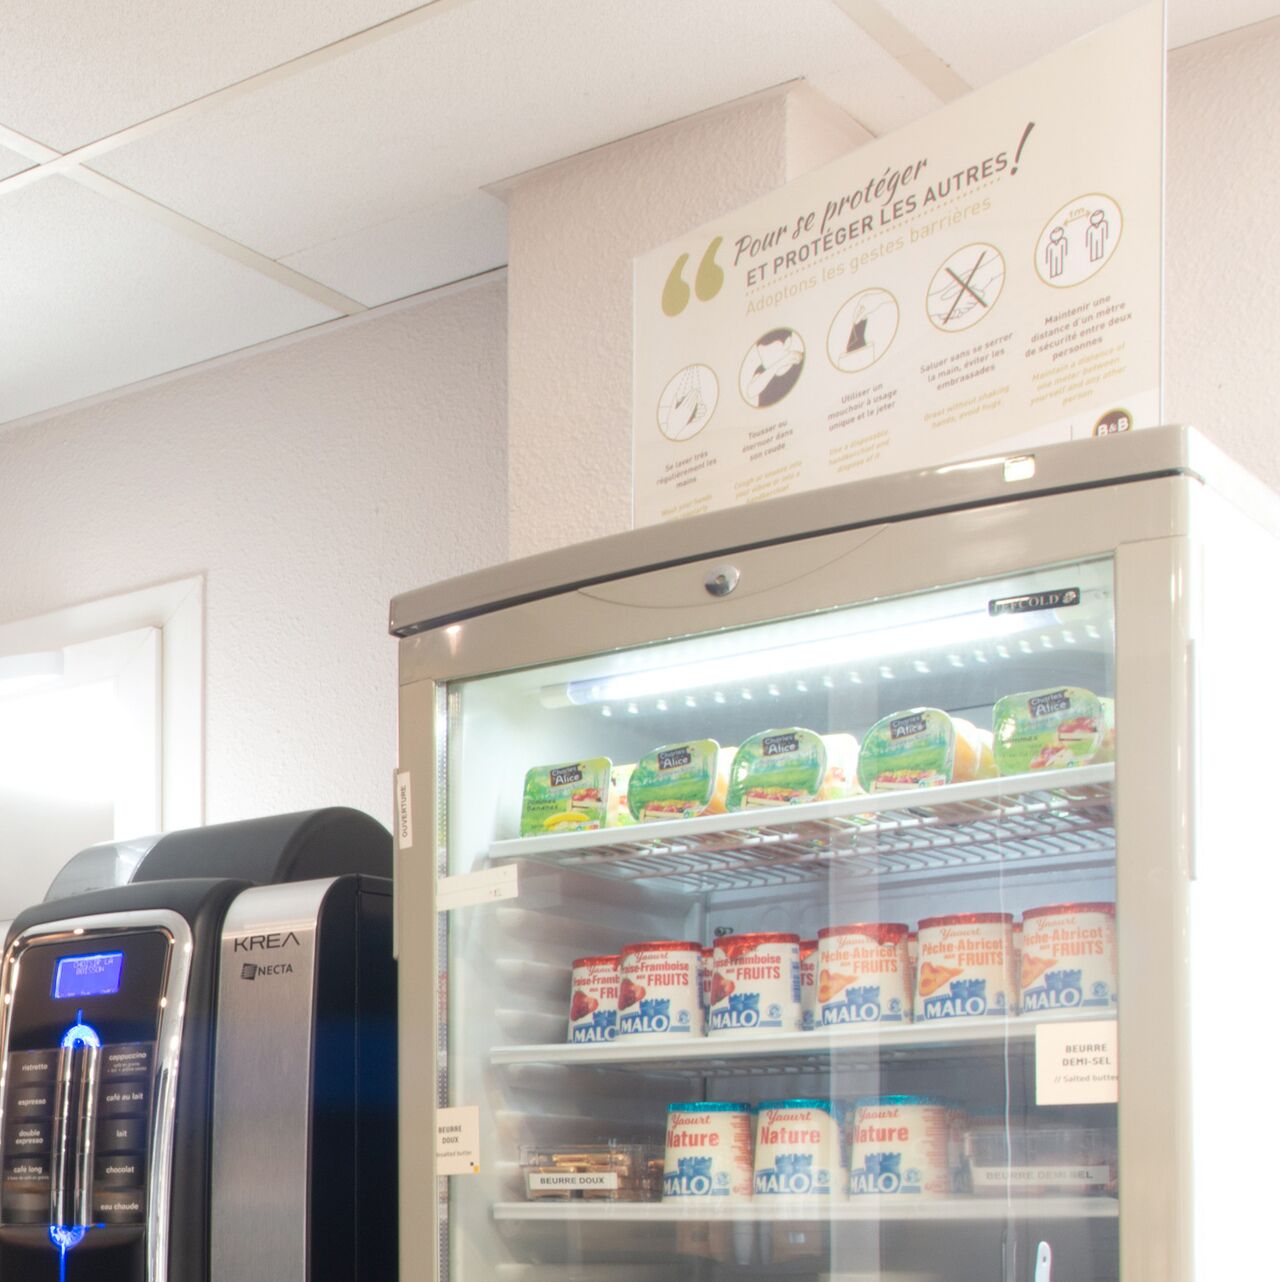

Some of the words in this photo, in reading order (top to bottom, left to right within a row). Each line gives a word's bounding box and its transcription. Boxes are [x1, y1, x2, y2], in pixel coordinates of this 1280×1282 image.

[734, 225, 787, 266] Pour
[792, 212, 815, 240] se
[820, 158, 927, 235] protéger
[746, 263, 768, 287] ET
[773, 215, 873, 274] PROTÉGER
[880, 194, 917, 225] LES
[746, 279, 817, 316] Adoptons
[822, 265, 844, 283] les
[850, 237, 904, 273] gestes
[909, 197, 991, 243] barrières
[1044, 302, 1091, 325] Maintenir
[1092, 295, 1111, 307] une
[1024, 348, 1036, 358] de
[1038, 332, 1077, 353] sécurité
[1079, 322, 1106, 337] entre
[1108, 312, 1133, 327] deux
[1031, 323, 1070, 343] distance
[920, 358, 948, 374] Saluer
[950, 349, 970, 362] sans
[985, 332, 1013, 349] serrer
[1052, 336, 1103, 361] personnes
[936, 364, 995, 391] embrassades
[841, 387, 870, 404] Utiliser
[827, 401, 864, 421] mouchoir
[873, 389, 897, 403] usage
[749, 425, 776, 440] Tousser
[829, 417, 855, 432] unique
[775, 429, 793, 442] dans
[764, 443, 786, 457] coude
[399, 785, 408, 838] OUVERTURE
[1052, 941, 1104, 957] FRUITS
[853, 960, 898, 974] FRUITS
[957, 951, 1004, 967] FRUITS
[258, 963, 293, 976] NECTA
[736, 966, 781, 980] FRUITS
[647, 973, 689, 987] FRUITS
[926, 997, 986, 1019] MALO
[1024, 988, 1080, 1012] MALO
[712, 1009, 758, 1030] MALO
[823, 1003, 880, 1026] MALO
[621, 1015, 668, 1034] MALO
[1065, 1043, 1108, 1054] BEURRE
[109, 1052, 147, 1062] cappuccino
[1062, 1057, 1111, 1067] DEMI-SEL
[22, 1063, 48, 1071] ristretto
[1063, 1074, 1090, 1082] Salted
[106, 1093, 121, 1102] café
[122, 1093, 131, 1101] au
[132, 1092, 143, 1100] lait
[671, 1114, 711, 1129] Yaourt
[766, 1110, 812, 1126] Yaourt
[19, 1129, 40, 1137] double
[116, 1129, 127, 1137] lait
[442, 1136, 459, 1144] DOUX
[667, 1130, 720, 1149] Nature
[760, 1126, 821, 1146] Nature
[13, 1165, 27, 1174] café
[28, 1165, 42, 1175] long
[106, 1166, 135, 1174] chocolat
[540, 1176, 577, 1185] BEURRE
[579, 1176, 605, 1185] DOUX
[664, 1175, 711, 1197] MALO
[756, 1172, 810, 1194] MALO
[114, 1202, 139, 1210] chaude
